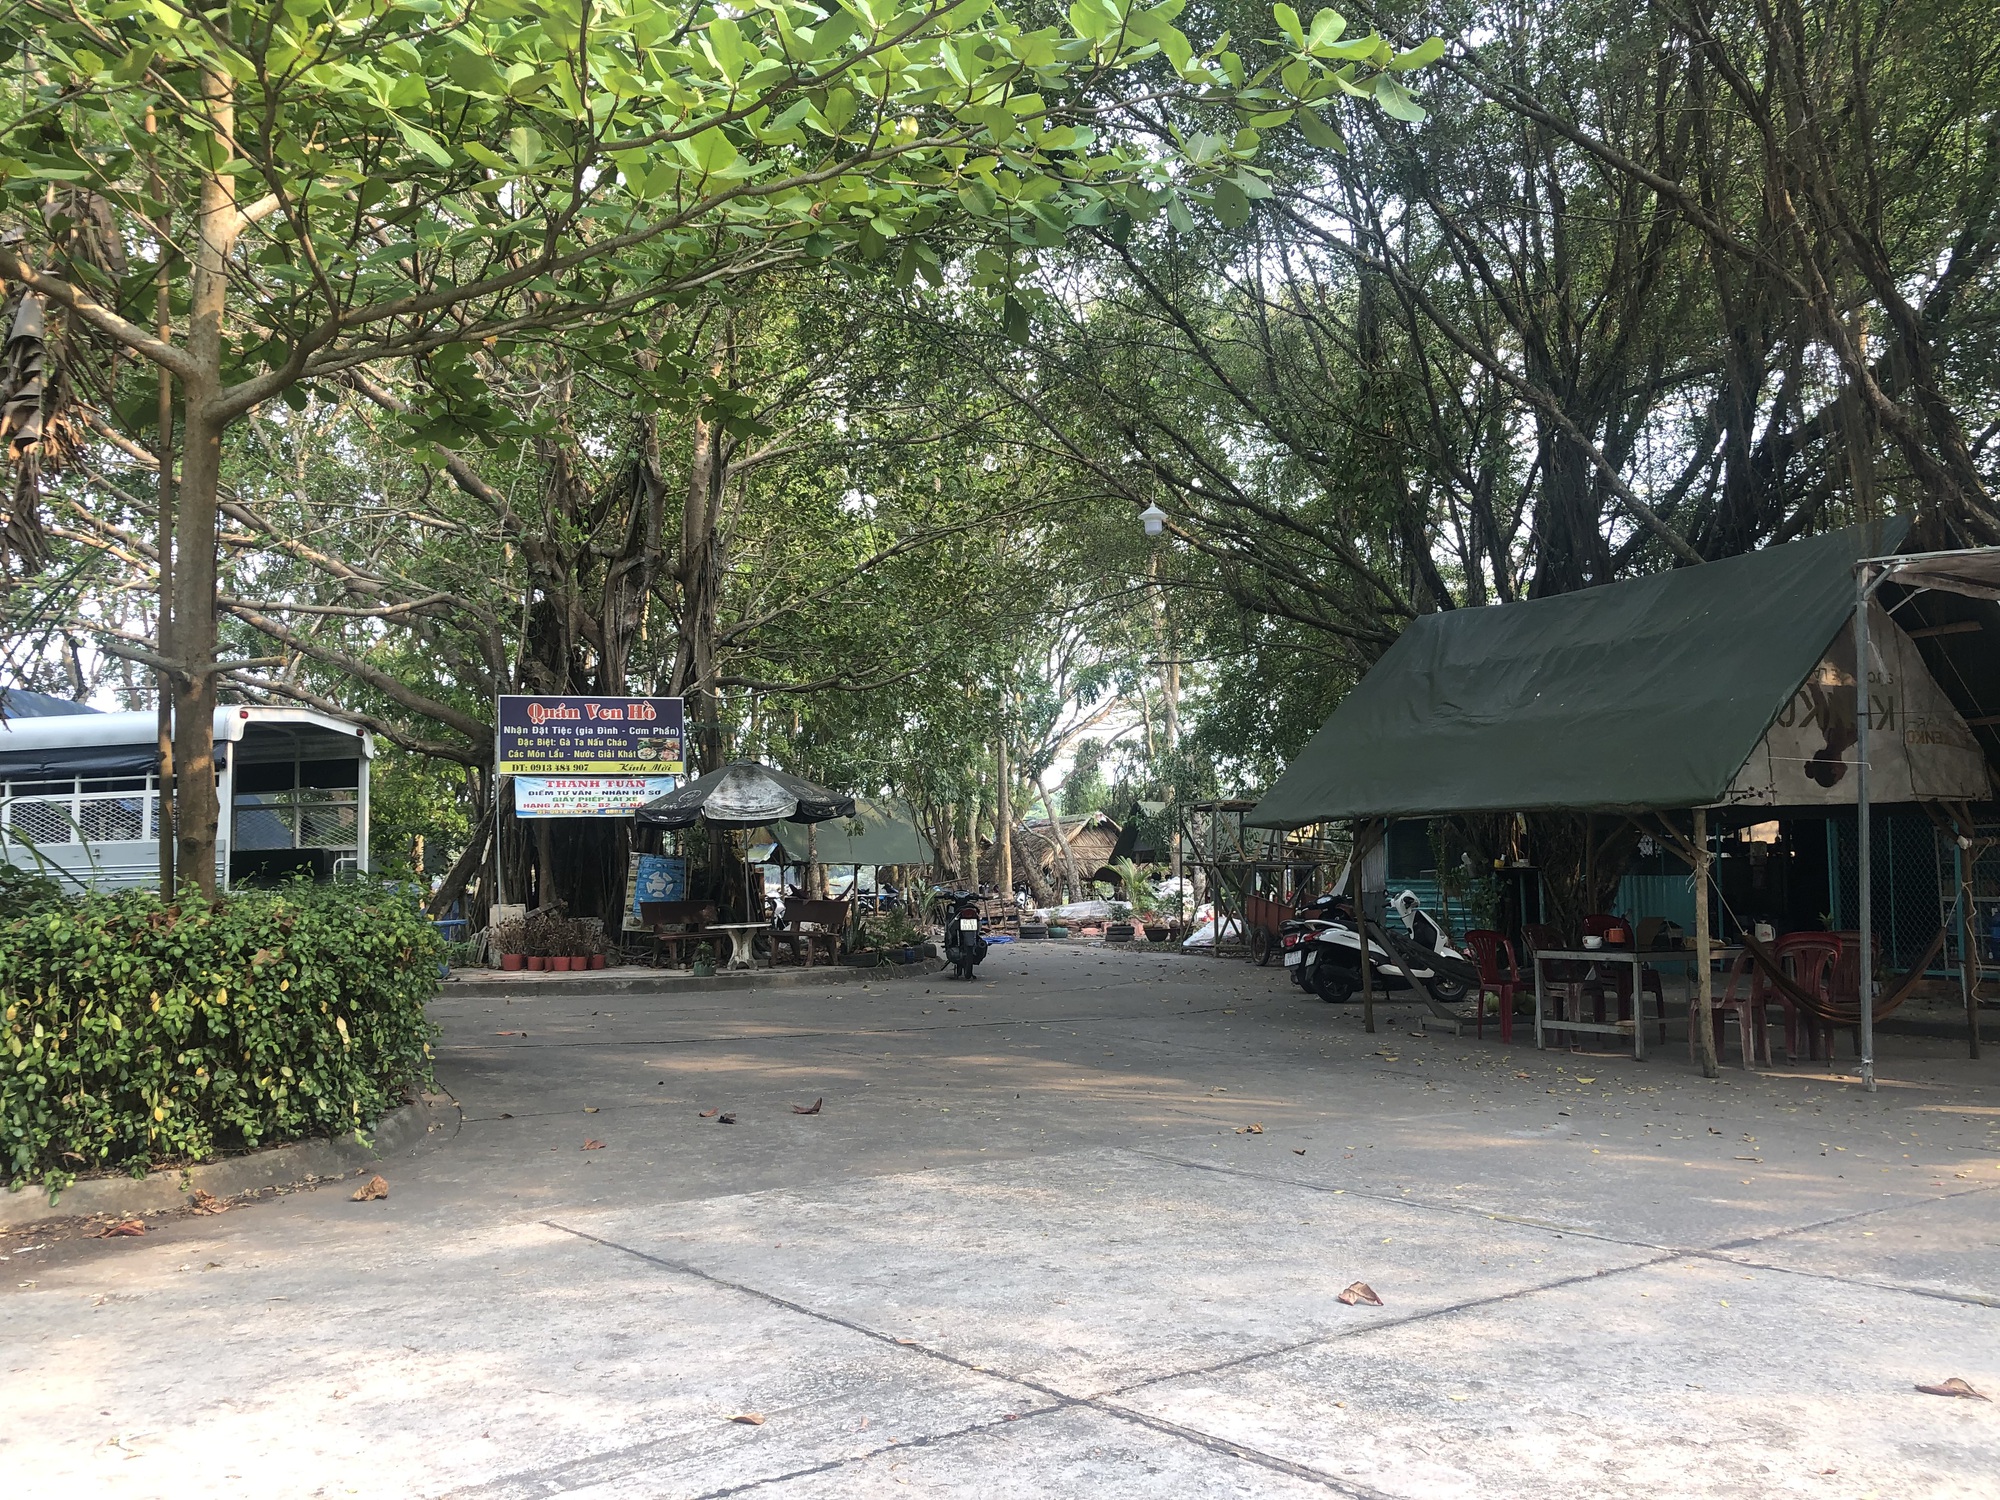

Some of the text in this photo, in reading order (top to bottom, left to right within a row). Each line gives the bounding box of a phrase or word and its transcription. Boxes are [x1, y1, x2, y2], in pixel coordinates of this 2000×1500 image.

[527, 700, 657, 725] Quán Ven Hồ
[503, 726, 528, 735] Nhận
[532, 726, 549, 735] Đạt
[552, 726, 572, 735] Tiệc
[575, 726, 593, 736] (gia
[597, 727, 618, 735] Đình
[629, 727, 649, 735] Cơm
[517, 737, 628, 747] Đặc Biệt: Gà Ta Nấu Cháo
[508, 750, 524, 758] Các
[527, 750, 545, 758] Món
[548, 748, 564, 758] Lẩu
[574, 750, 595, 758] Nước
[597, 749, 615, 758] Giải
[617, 750, 636, 758] Khát
[617, 763, 672, 771] Kính Mời
[545, 780, 600, 788] THANH
